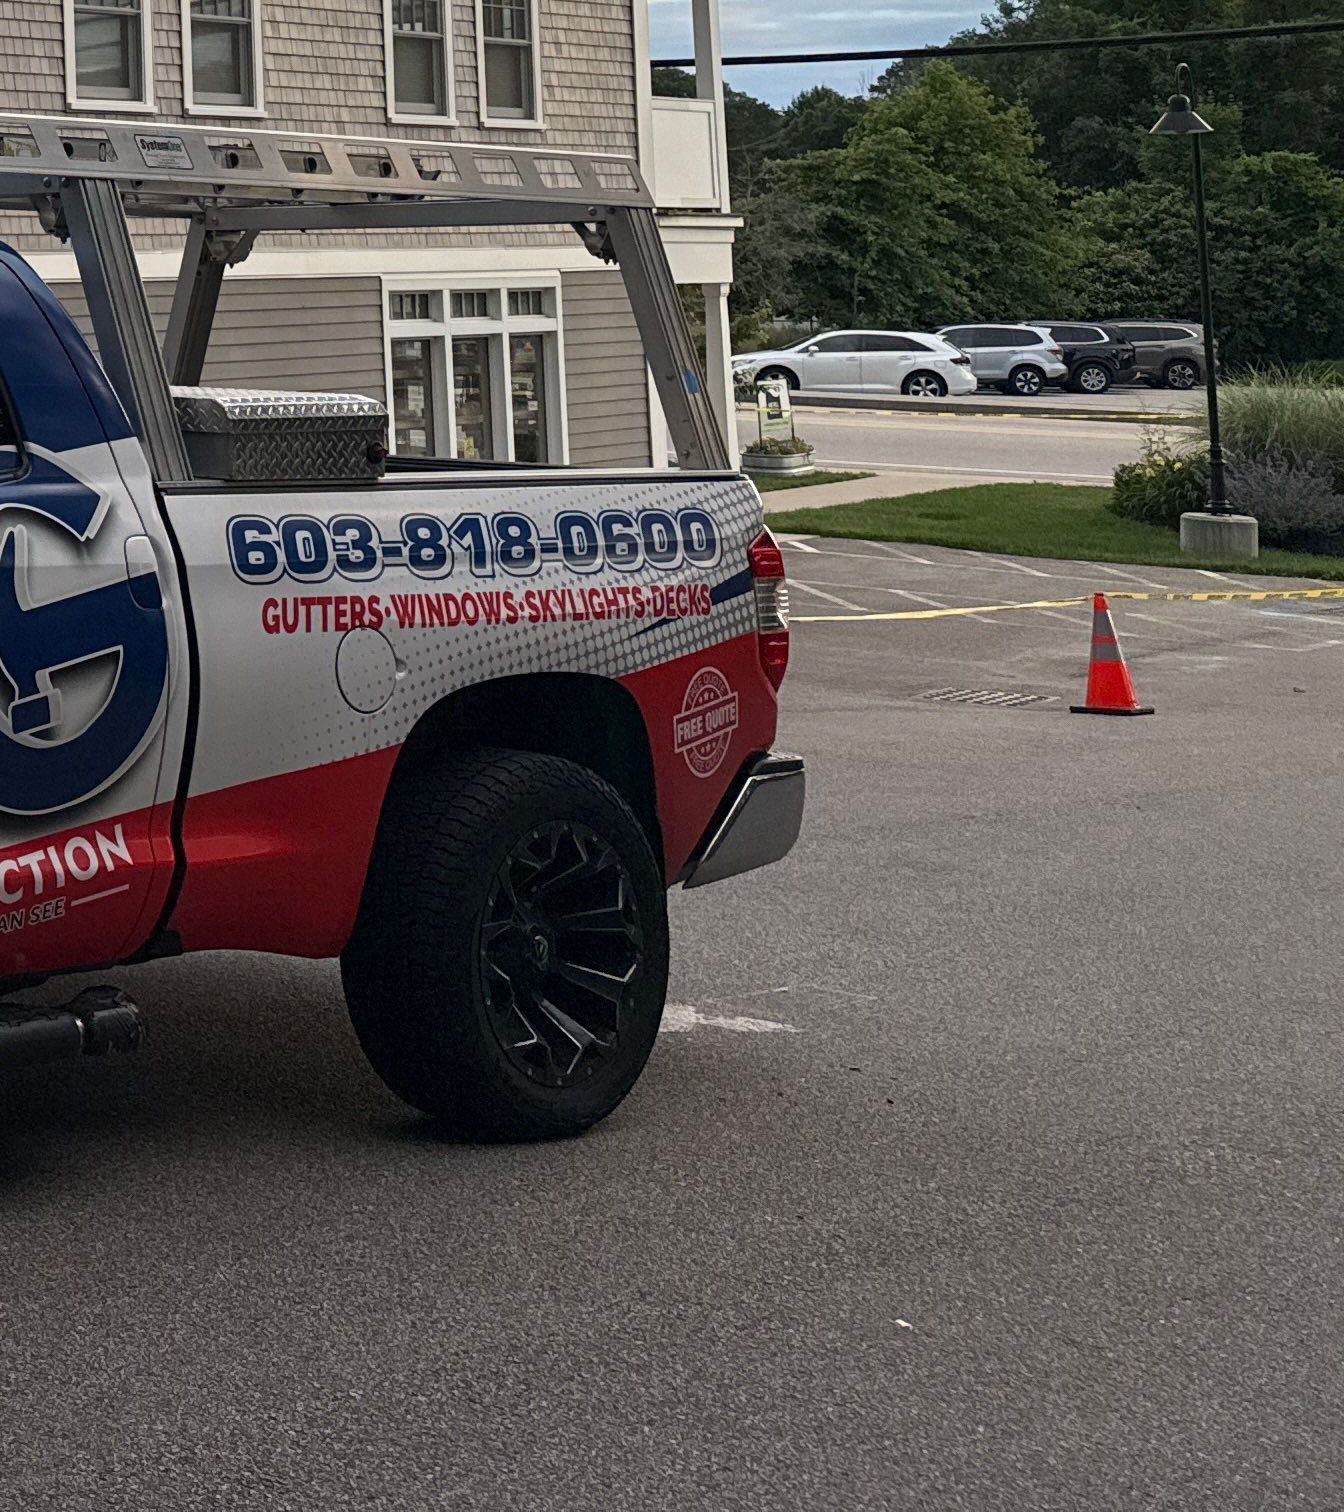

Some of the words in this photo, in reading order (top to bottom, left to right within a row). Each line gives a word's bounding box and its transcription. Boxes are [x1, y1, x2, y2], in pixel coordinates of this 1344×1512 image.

[226, 509, 723, 584] 603-818-0600
[677, 715, 703, 744] FREE
[705, 701, 736, 733] QUOTE
[28, 896, 67, 925] SEE
